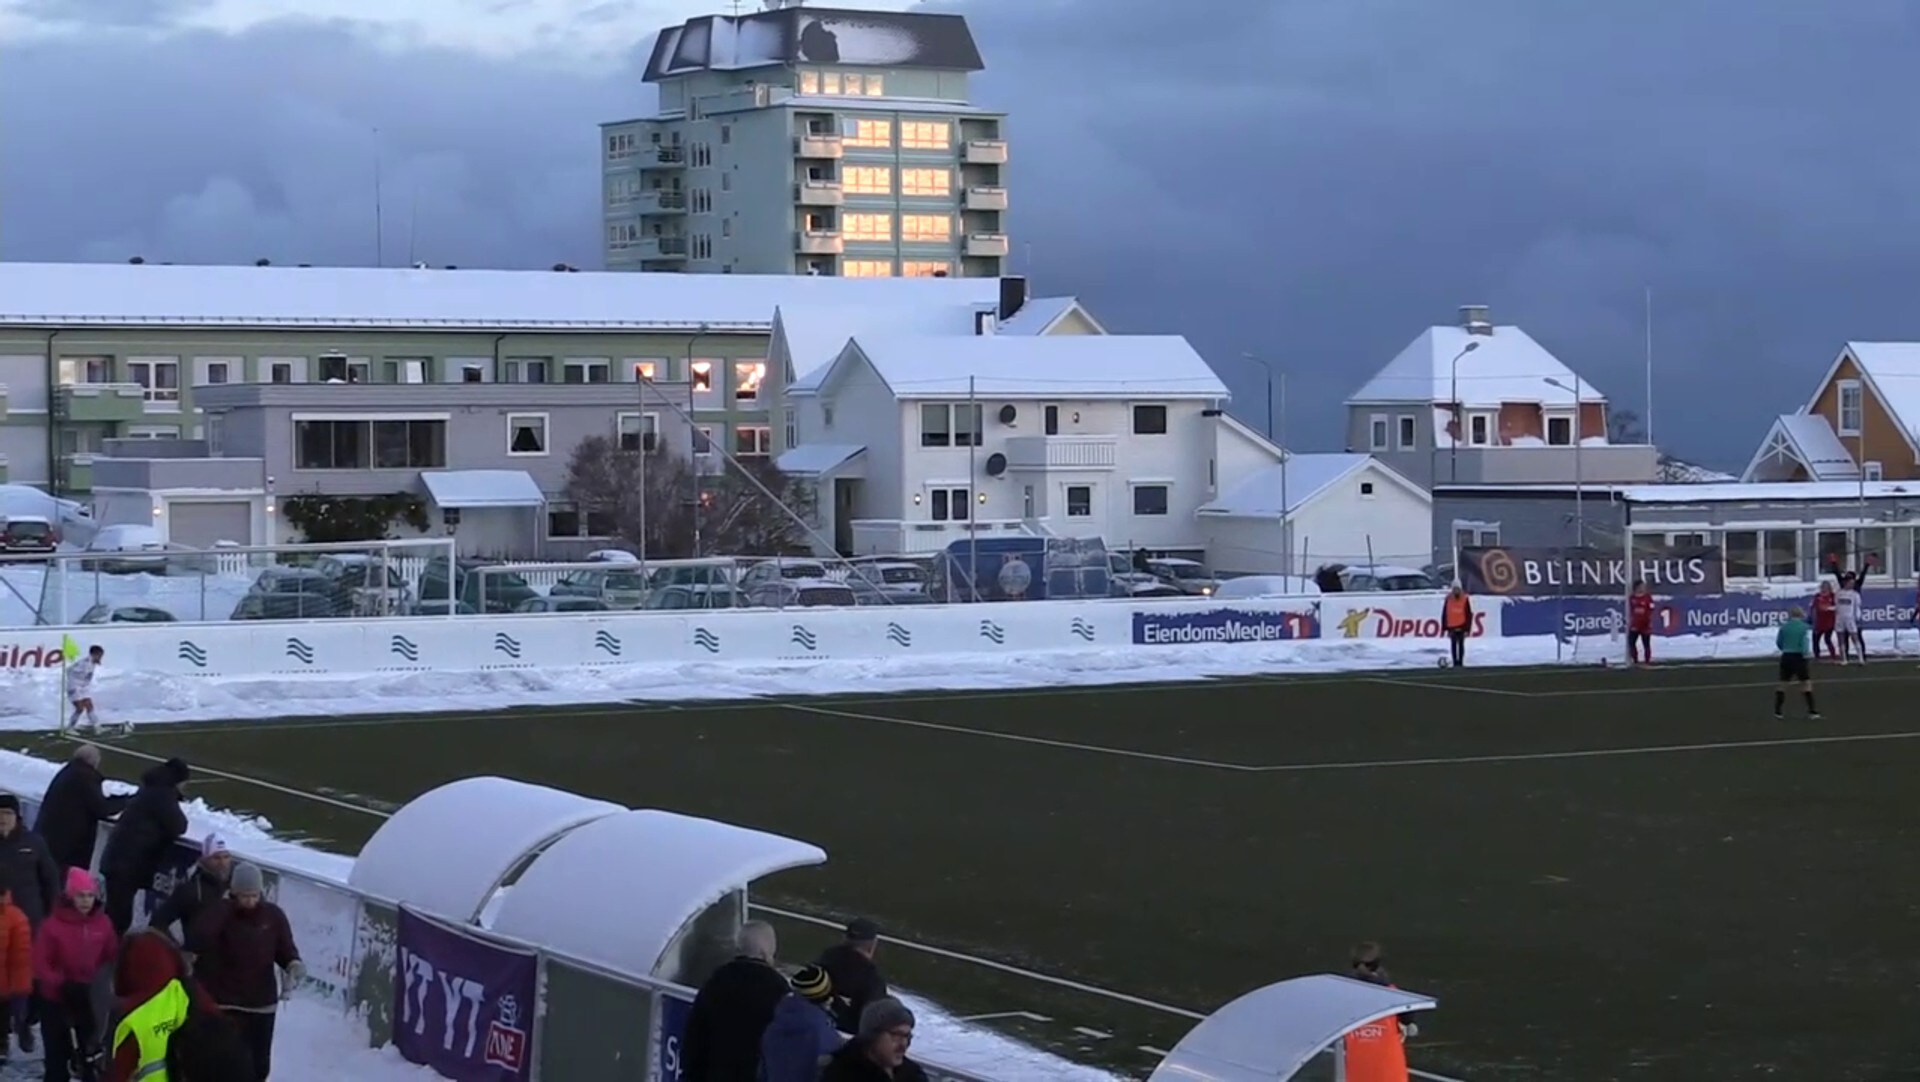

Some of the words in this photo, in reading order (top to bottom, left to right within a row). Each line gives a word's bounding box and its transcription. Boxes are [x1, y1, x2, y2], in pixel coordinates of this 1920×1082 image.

[1524, 559, 1626, 585] BLINK
[1640, 558, 1705, 584] HUS
[1143, 619, 1282, 643] EiendomsMegler
[1289, 617, 1300, 639] 1
[1687, 608, 1789, 627] Nord-Norge
[0, 644, 64, 668] ilde
